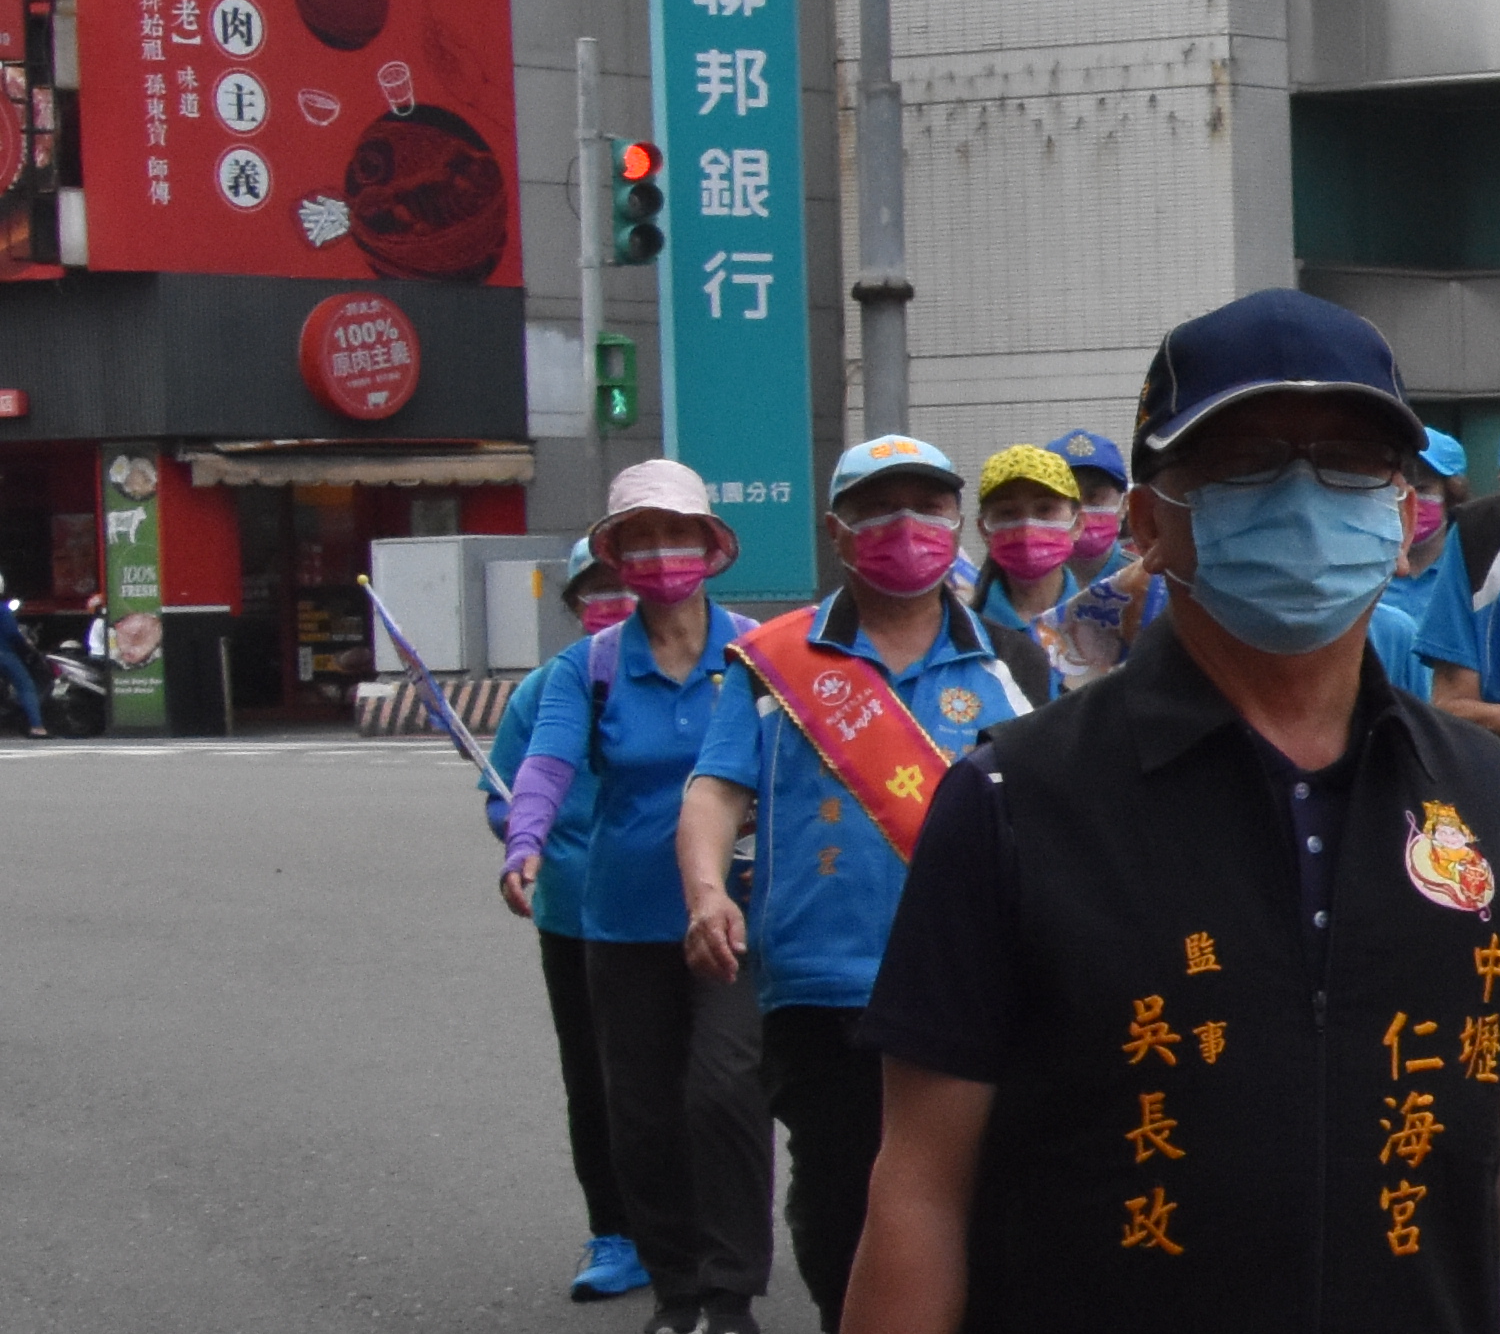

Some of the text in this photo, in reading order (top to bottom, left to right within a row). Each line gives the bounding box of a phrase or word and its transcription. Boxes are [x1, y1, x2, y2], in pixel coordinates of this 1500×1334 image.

[334, 317, 400, 349] 100%
[1184, 931, 1228, 1065] 監事
[1120, 994, 1186, 1257] 吳長政
[1378, 1010, 1446, 1258] 仁海宮
